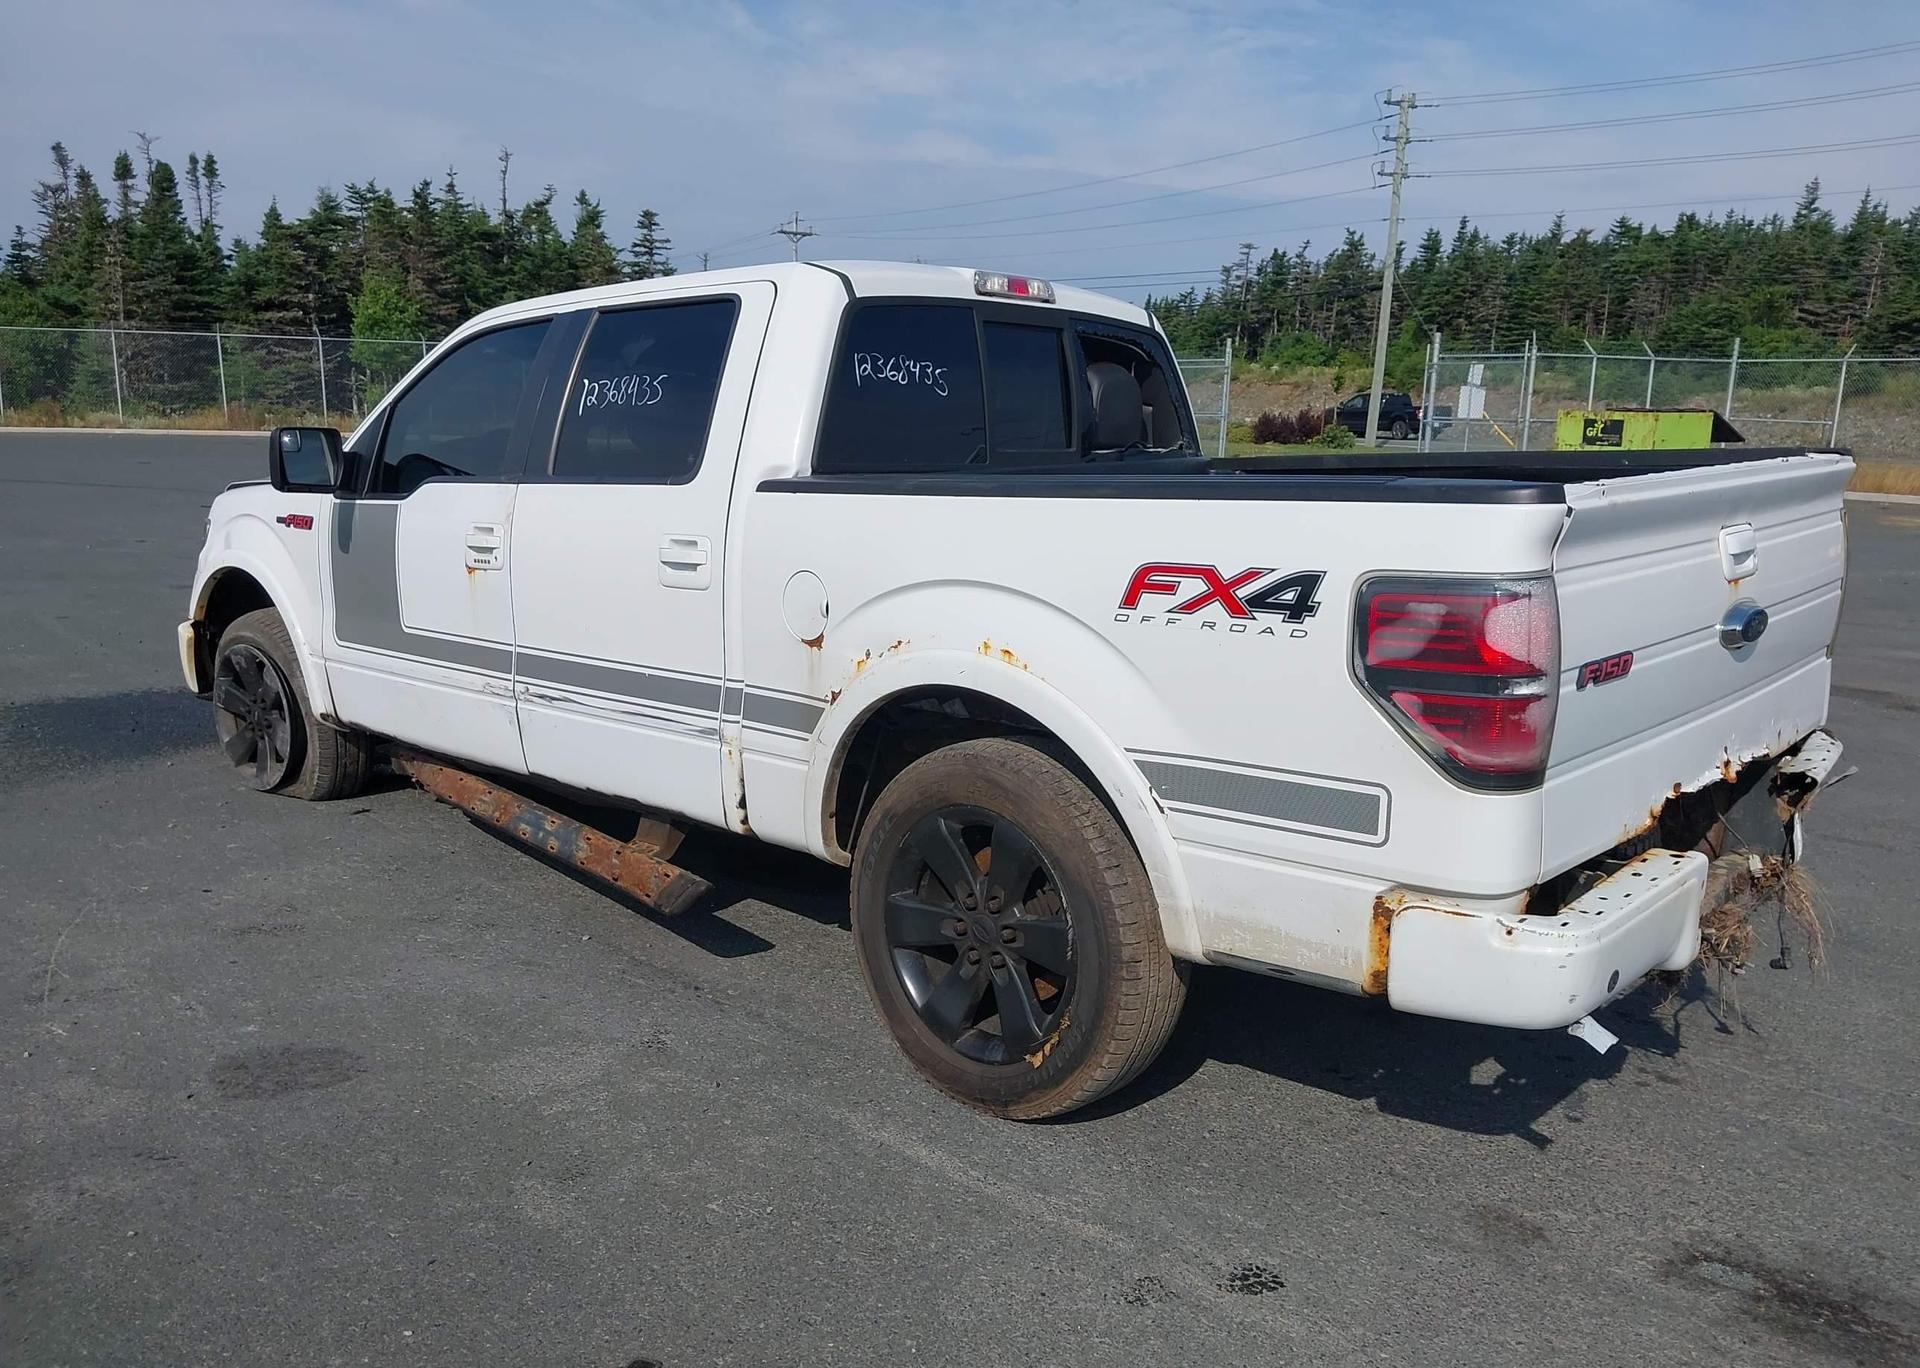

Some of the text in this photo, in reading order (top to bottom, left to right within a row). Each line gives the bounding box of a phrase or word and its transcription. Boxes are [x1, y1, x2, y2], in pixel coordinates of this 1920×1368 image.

[578, 374, 669, 416] 12368435
[854, 352, 949, 397] 12368435
[1118, 562, 1328, 624] FX4
[1200, 621, 1308, 639] ROAD
[1581, 652, 1634, 687] F-150
